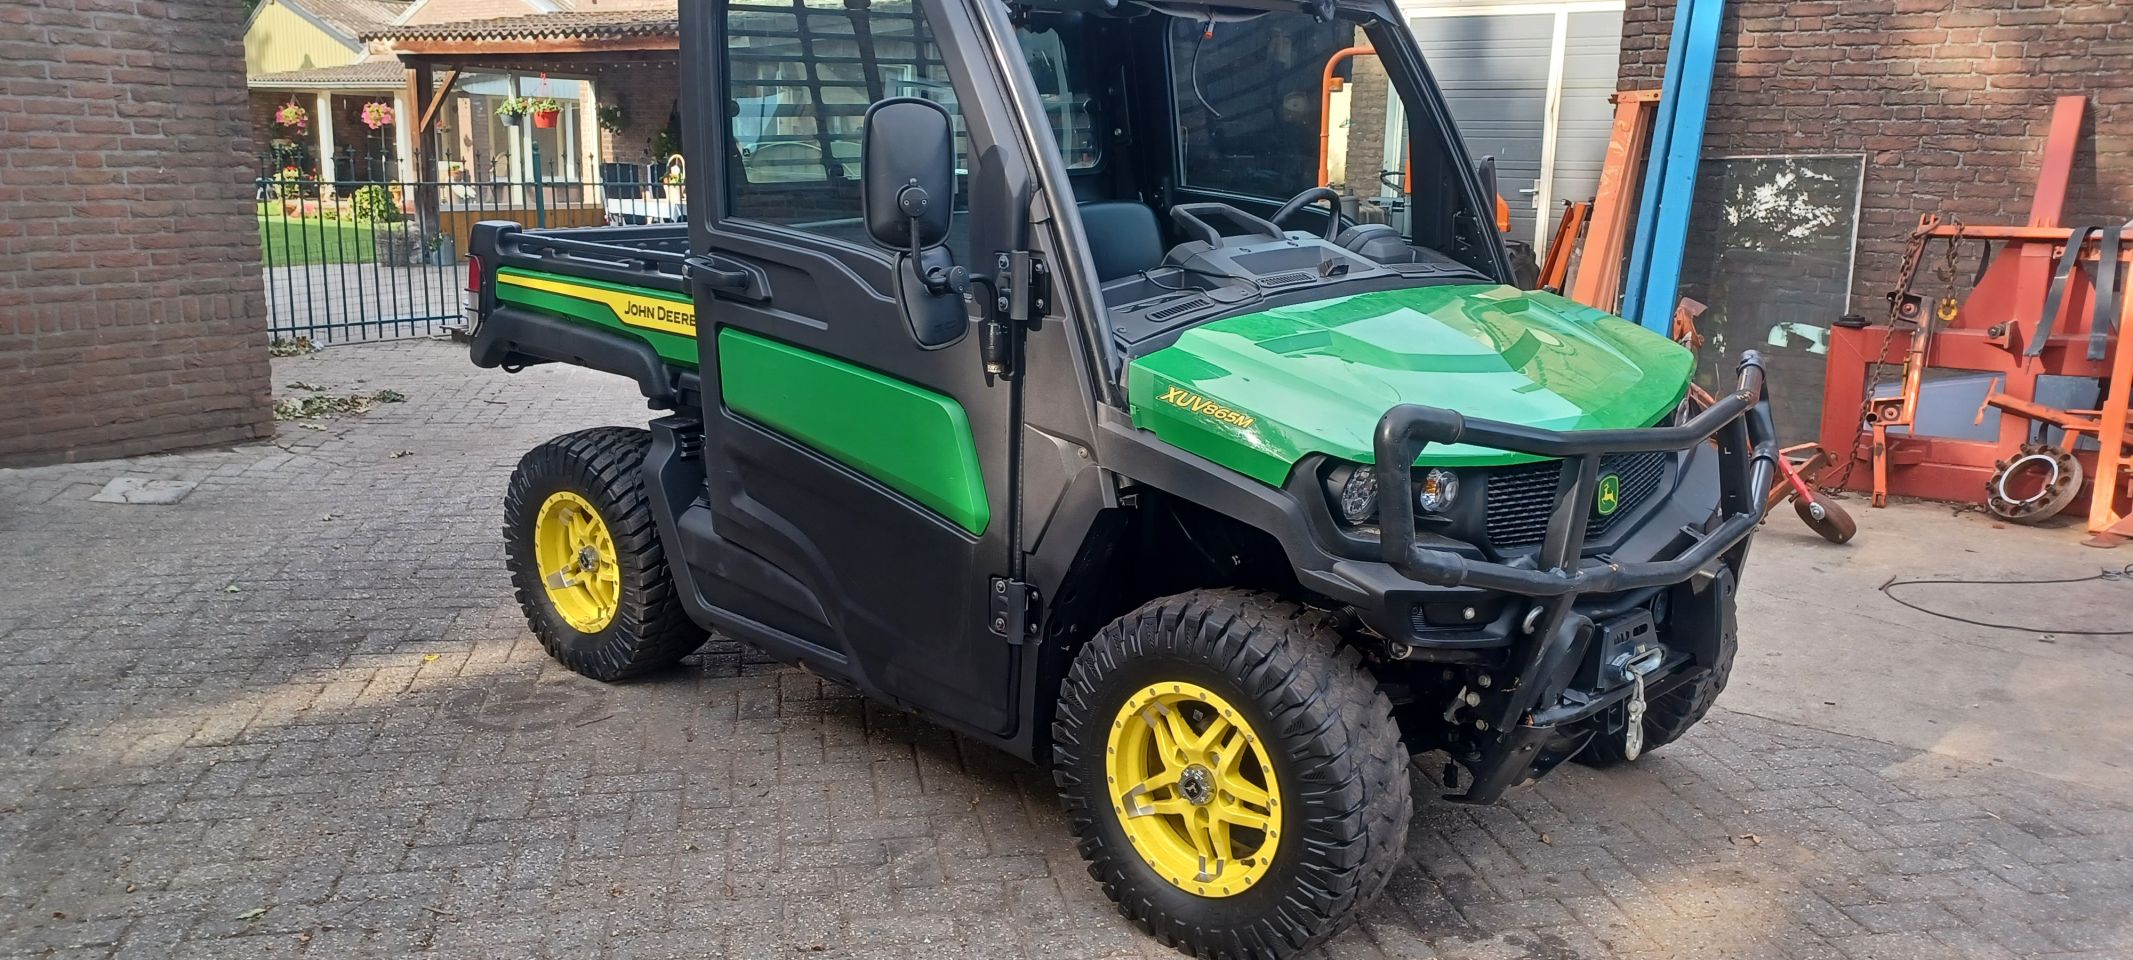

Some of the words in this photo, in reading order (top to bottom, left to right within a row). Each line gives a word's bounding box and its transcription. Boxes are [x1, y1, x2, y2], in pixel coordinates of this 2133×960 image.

[624, 300, 655, 319] JOHN
[657, 305, 696, 326] DEERE
[1156, 385, 1255, 429] XUV865M
